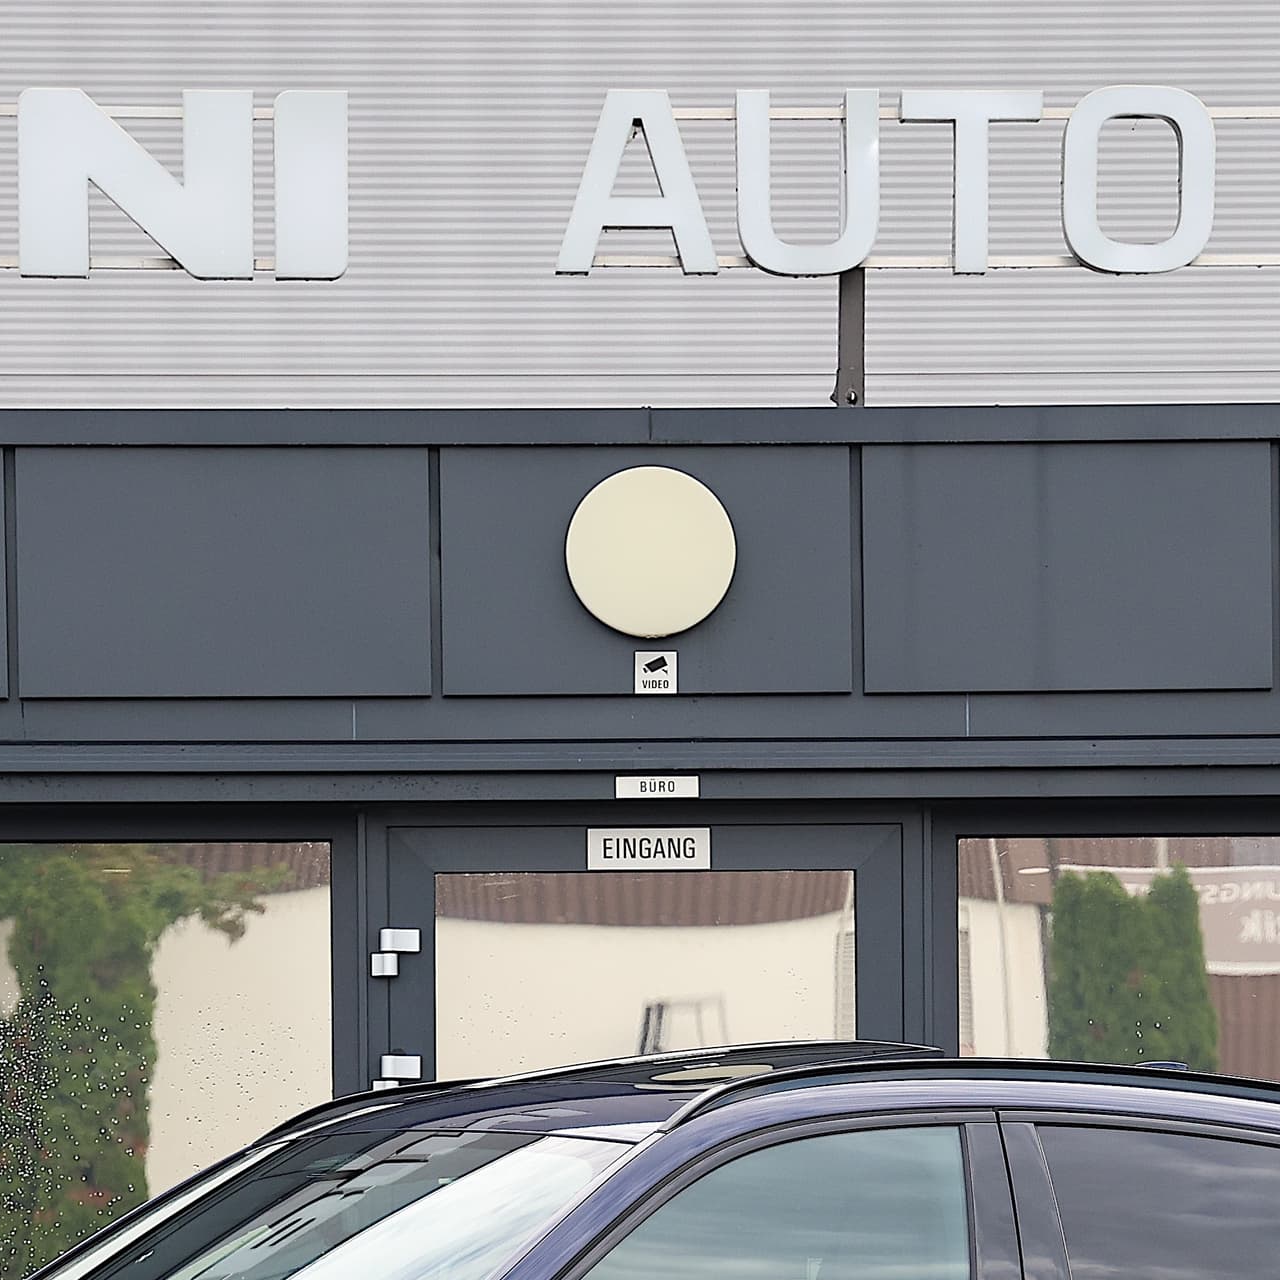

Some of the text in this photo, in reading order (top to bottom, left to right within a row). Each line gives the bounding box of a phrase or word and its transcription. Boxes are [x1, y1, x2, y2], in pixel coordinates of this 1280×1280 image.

[554, 83, 1216, 277] AUTO
[642, 679, 669, 689] VIDEO
[639, 778, 676, 793] BÜRO
[602, 837, 696, 859] EINGANG
